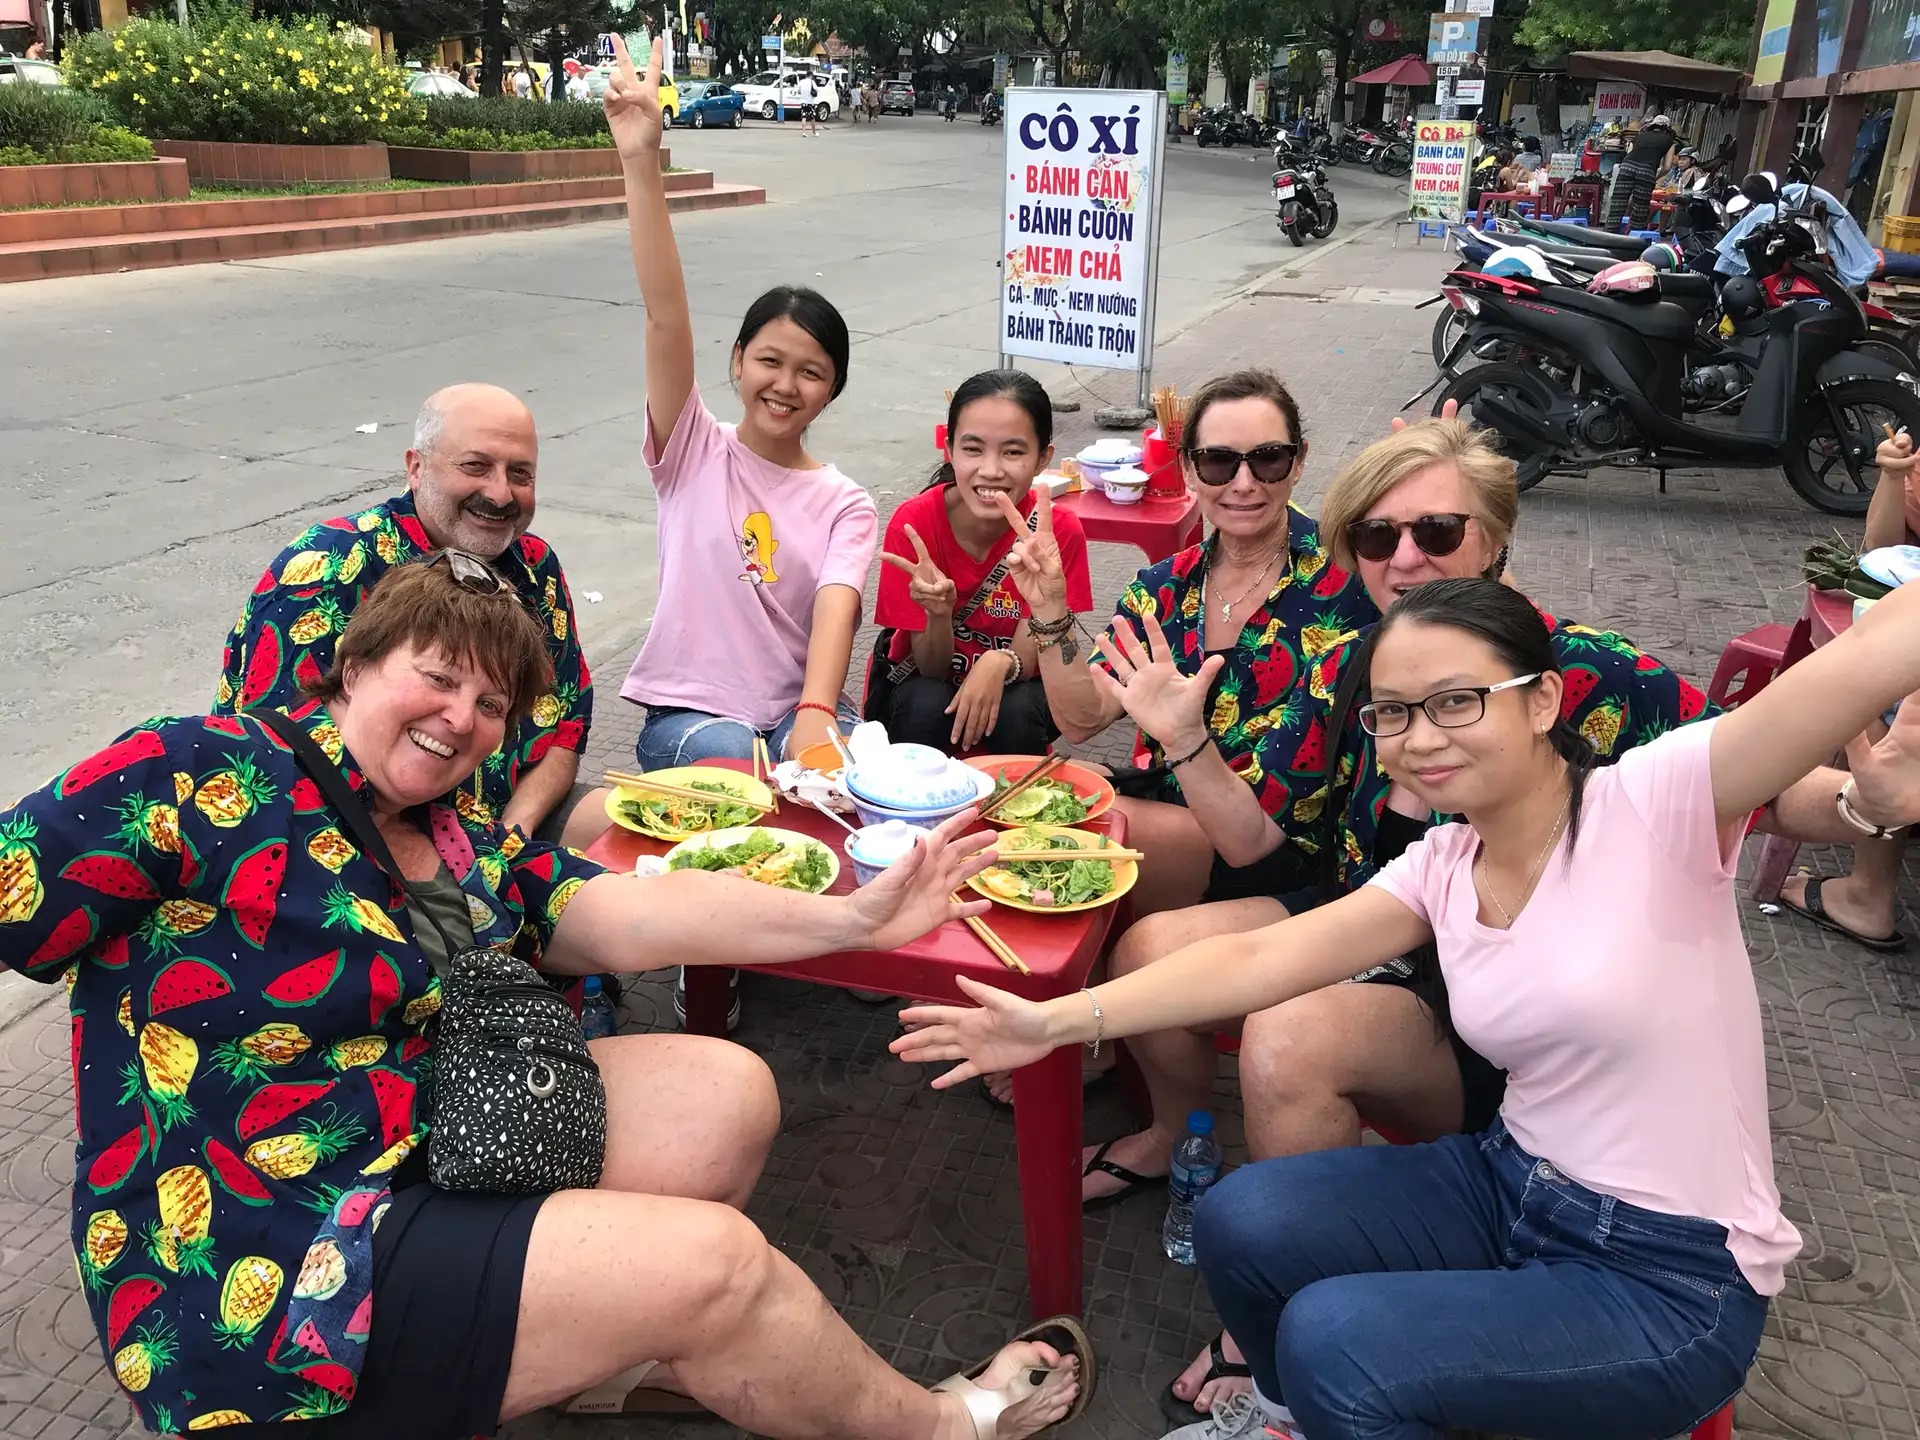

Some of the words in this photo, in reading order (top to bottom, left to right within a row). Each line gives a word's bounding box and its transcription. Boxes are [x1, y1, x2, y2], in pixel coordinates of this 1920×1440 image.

[1441, 22, 1464, 50] P
[1019, 102, 1079, 152] CÔ
[1088, 105, 1140, 155] XÍ
[1420, 126, 1440, 141] Cô
[1026, 160, 1080, 197] BÁNH
[1086, 163, 1128, 200] CĂN
[1414, 179, 1437, 192] NEM
[1018, 200, 1072, 236] BÁNH
[1078, 202, 1134, 242] CUỐN
[1025, 245, 1072, 277] NEM
[1079, 243, 1123, 281] CHẢ
[1008, 282, 1023, 304] CÁ
[1033, 287, 1058, 311] MỰC
[1068, 291, 1094, 312] NEM
[1097, 292, 1137, 317] NƯỚNG
[1007, 311, 1044, 342] BÁNH
[1048, 317, 1094, 348] TRÁNG
[1098, 323, 1136, 357] TRỘN
[984, 606, 1008, 617] FOOD
